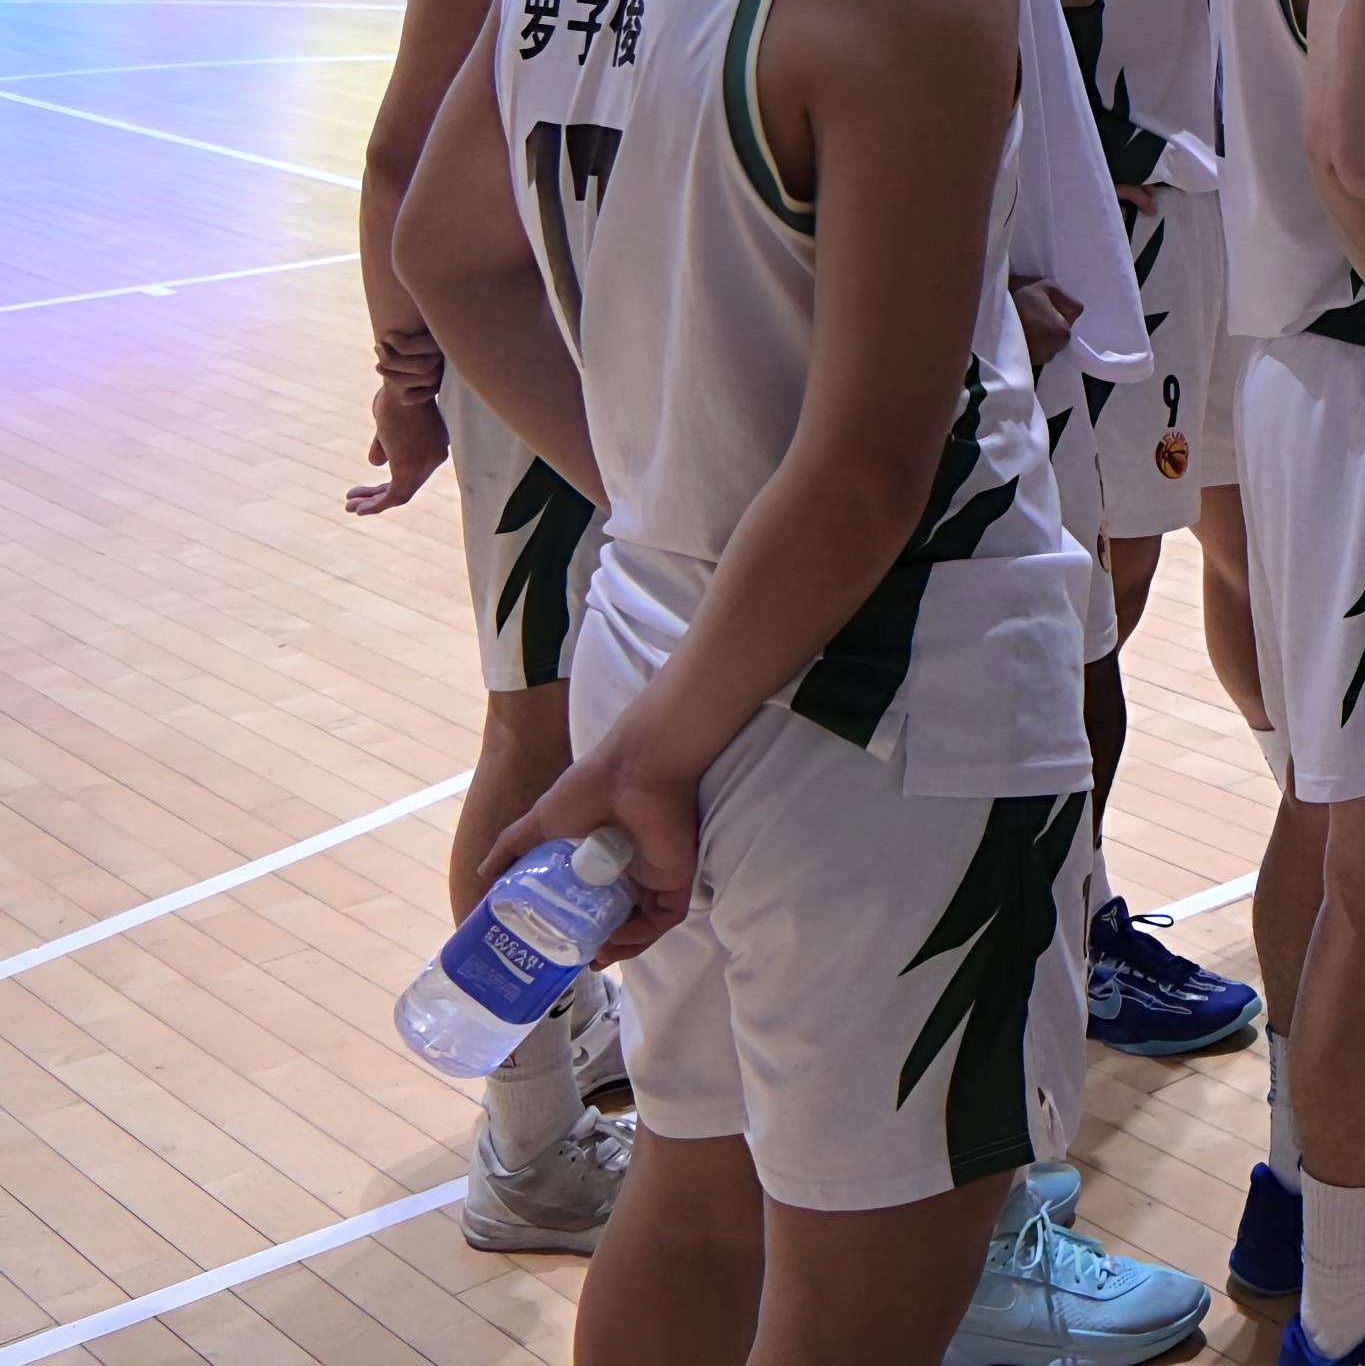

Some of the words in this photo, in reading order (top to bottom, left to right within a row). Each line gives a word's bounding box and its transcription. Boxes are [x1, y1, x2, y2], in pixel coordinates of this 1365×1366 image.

[1162, 374, 1181, 428] 9
[483, 931, 537, 971] SWEAT
[489, 924, 545, 970] POCARI
